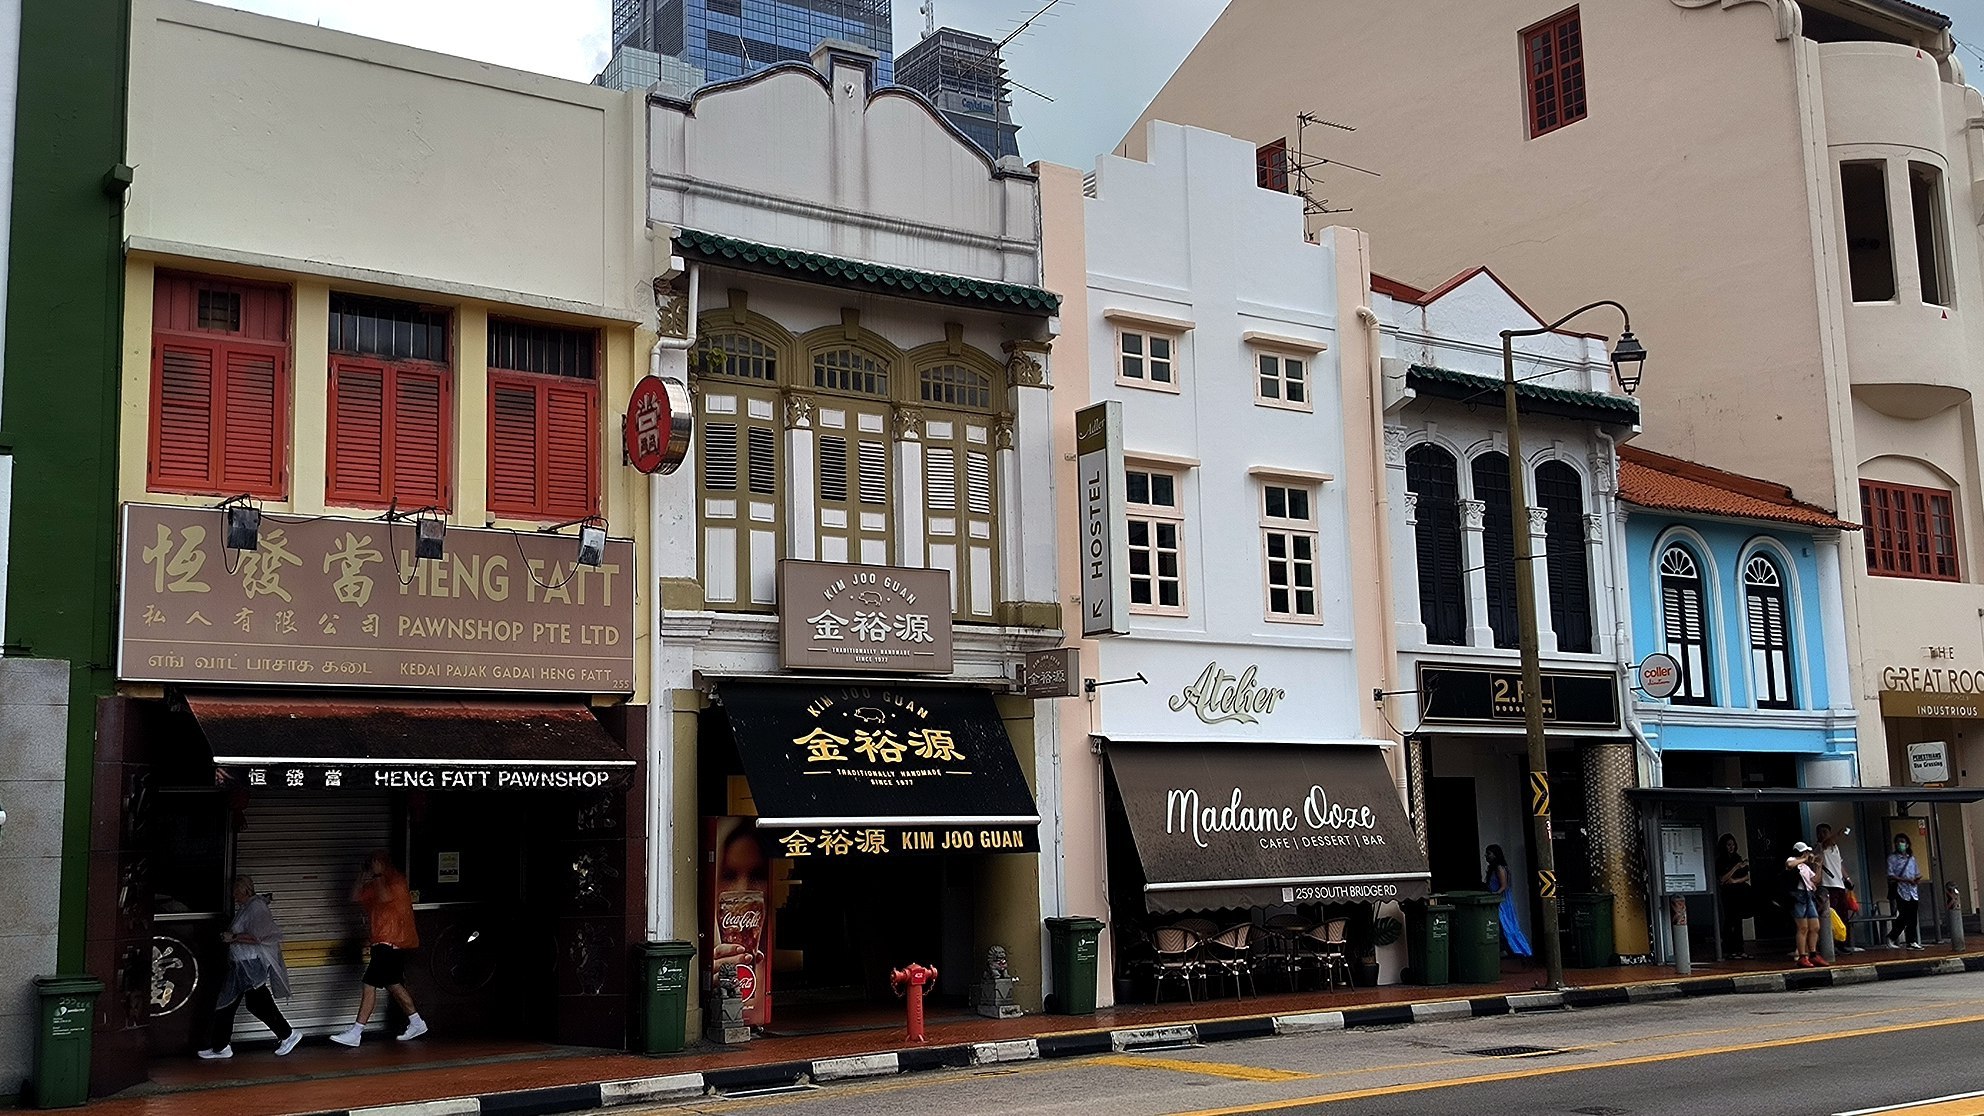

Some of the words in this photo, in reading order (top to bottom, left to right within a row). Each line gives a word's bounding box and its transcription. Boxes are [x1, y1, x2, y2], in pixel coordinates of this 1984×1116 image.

[636, 391, 661, 459] 當
[1089, 470, 1103, 579] HOSTEL
[400, 549, 509, 601] HENG
[527, 558, 620, 607] FATT
[823, 579, 846, 601] KIM
[852, 572, 876, 585] JOO
[884, 576, 916, 605] GUAN
[142, 604, 380, 638] 私人有限公司
[399, 615, 524, 642] PAWNSHOP
[533, 622, 571, 644] PTE
[581, 625, 620, 646] LTD
[807, 609, 934, 643] 金裕源
[832, 647, 877, 655] TRADITIONALLY
[1928, 646, 1954, 659] THE
[400, 662, 440, 676] KEDAI
[446, 664, 486, 678] PAJAK
[492, 666, 535, 679] GADAI
[541, 667, 575, 680] HENG
[581, 669, 612, 681] FATT
[613, 680, 630, 689] 255
[1883, 666, 1942, 693] GREAT
[807, 694, 833, 717] KIM
[842, 687, 871, 700] JOO
[883, 691, 928, 719] GUAN
[1168, 661, 1286, 725] Atelier
[1917, 706, 1978, 716] INDUSTRIOUS
[793, 727, 966, 763] 金裕源
[375, 770, 435, 787] HENG
[441, 770, 491, 787] FATT
[499, 770, 610, 788] PAWNSHOP
[837, 768, 895, 777] TRADITIONALLY
[900, 769, 941, 777] HANDMADE
[870, 778, 893, 786] SINCE
[1166, 787, 1298, 848] Madame
[1303, 784, 1376, 830] Ooze
[779, 828, 890, 857] 金裕源
[902, 831, 935, 850] KIM
[942, 830, 974, 849] JOO
[979, 830, 1024, 848] GUAN
[1259, 837, 1290, 850] CAFE
[1302, 834, 1351, 848] DESSERT
[1363, 834, 1386, 846] BAR
[1296, 887, 1313, 900] 259
[1314, 886, 1348, 898] SOUTH
[1349, 885, 1383, 897] BRIDGE
[1384, 884, 1397, 896] RD
